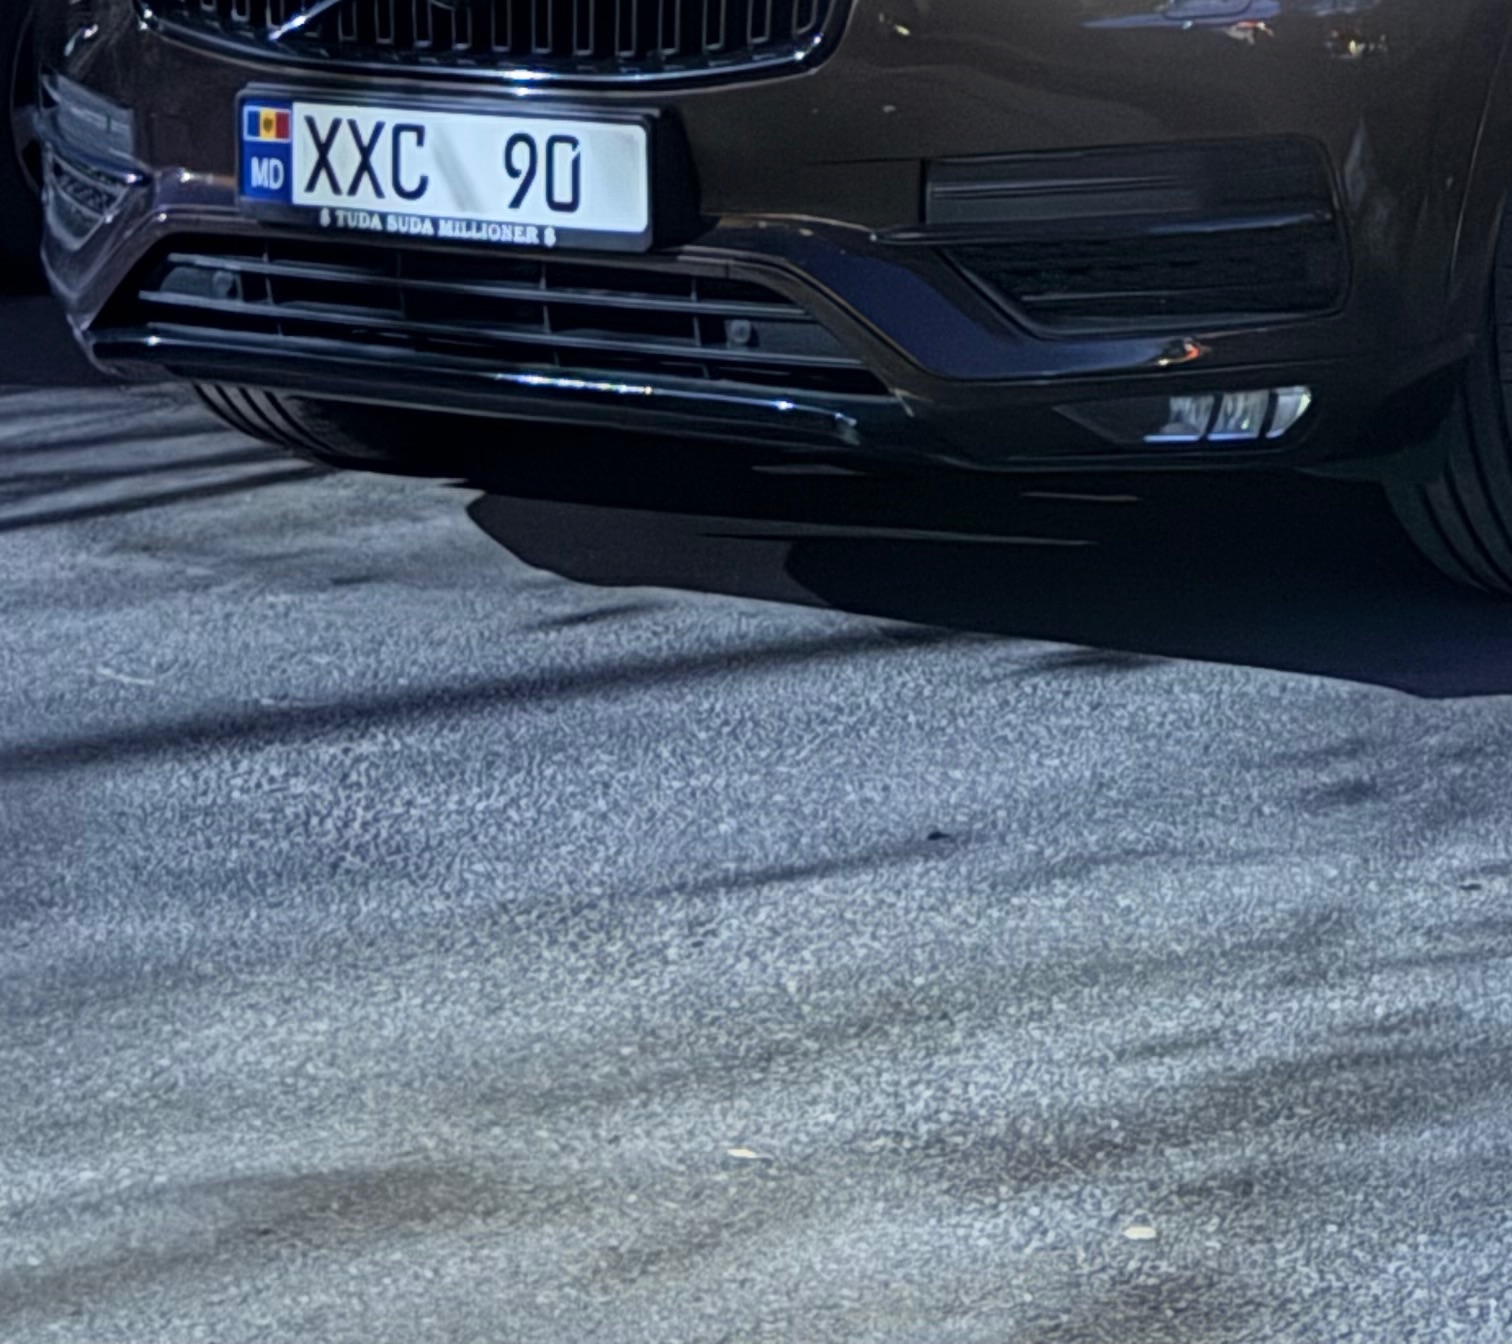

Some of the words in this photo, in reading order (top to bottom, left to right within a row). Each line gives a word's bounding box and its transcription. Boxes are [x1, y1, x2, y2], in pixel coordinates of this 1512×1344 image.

[251, 156, 285, 190] MD
[304, 115, 429, 200] XXC
[504, 132, 582, 213] 90
[335, 209, 383, 231] TUDA
[386, 214, 435, 236] SUDA
[438, 218, 540, 244] MILLIONER
